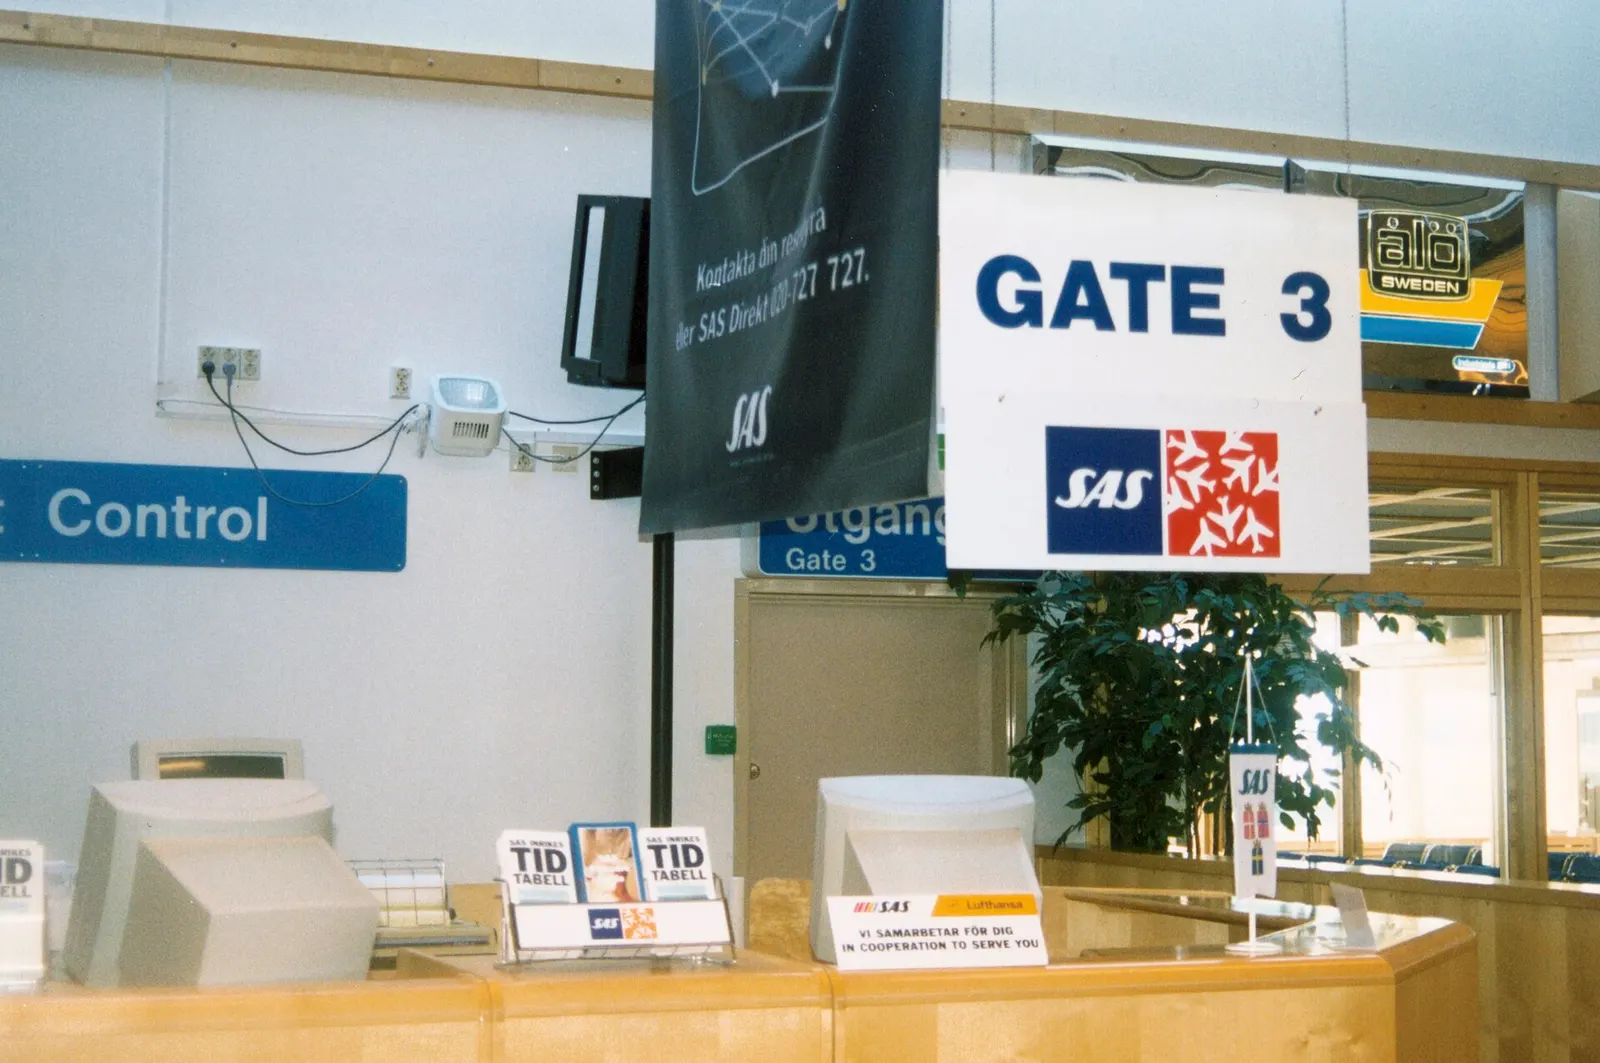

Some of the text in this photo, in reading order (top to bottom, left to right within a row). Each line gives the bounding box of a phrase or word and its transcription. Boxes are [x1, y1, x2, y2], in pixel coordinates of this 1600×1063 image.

[696, 250, 756, 292] Kontakta
[759, 236, 778, 268] din
[698, 308, 726, 342] SAS
[728, 293, 769, 333] Direkt
[827, 246, 870, 291] 727.
[1381, 275, 1460, 294] SWEDEN
[976, 254, 1332, 342] GATE 3
[725, 384, 773, 453] SAS
[1055, 468, 1154, 510] SAS
[48, 488, 268, 541] Control
[785, 547, 877, 572] Gate 3
[1238, 768, 1271, 796] SAS
[509, 847, 568, 874] TID
[646, 844, 705, 869] TID
[512, 873, 570, 887] TABELL
[651, 869, 708, 881] TABELL
[878, 900, 911, 914] SAS
[966, 899, 1024, 910] Lufthansa
[592, 917, 619, 930] SAS
[859, 924, 1014, 939] VI SAMARBETAR FÖR DIG
[842, 938, 1039, 953] IN COOPERATION TO SERVE YOU
